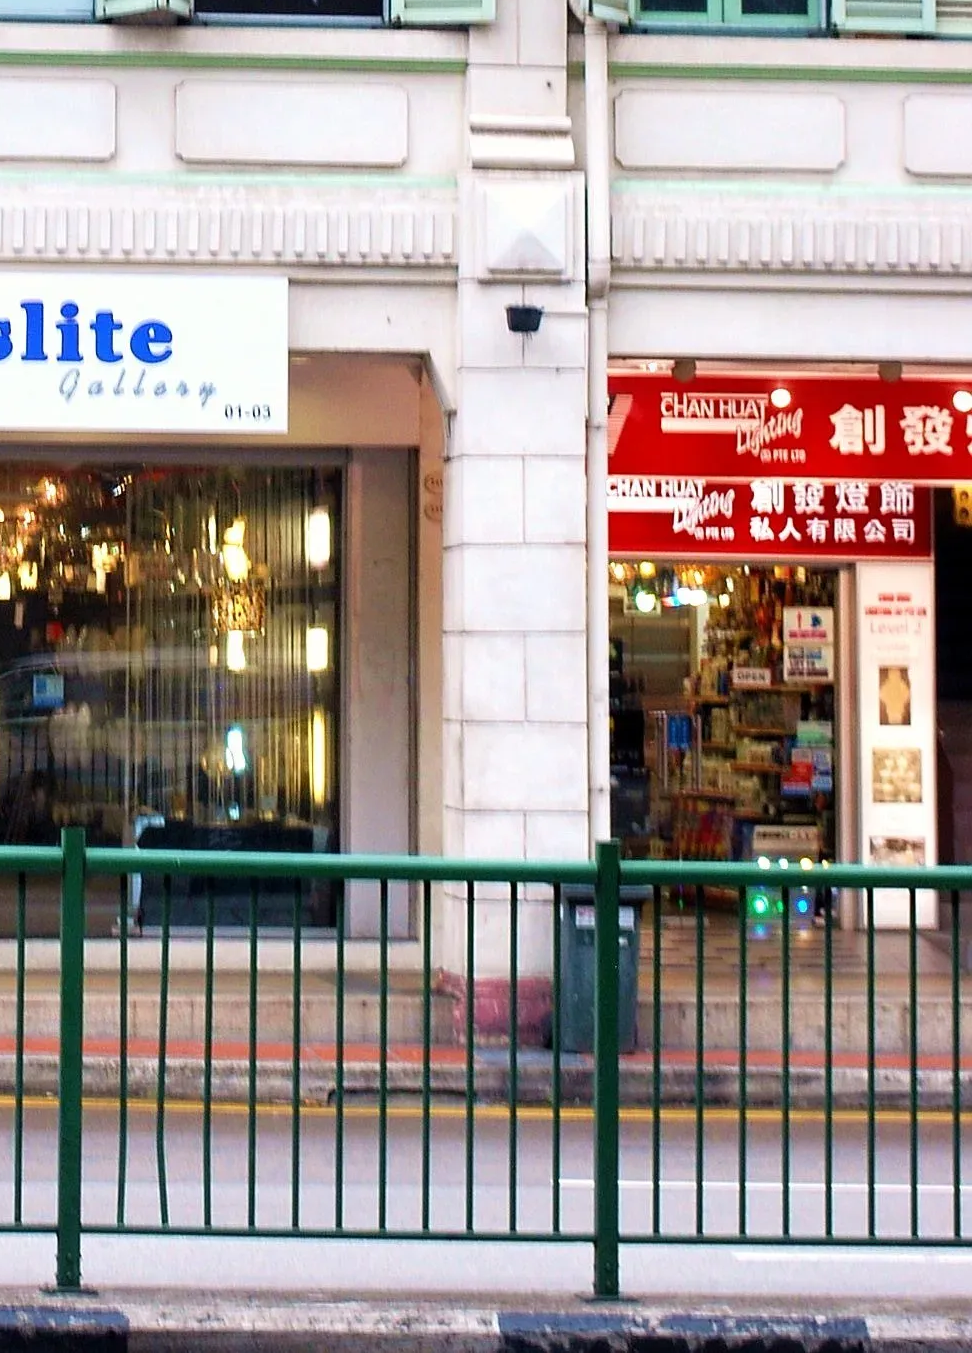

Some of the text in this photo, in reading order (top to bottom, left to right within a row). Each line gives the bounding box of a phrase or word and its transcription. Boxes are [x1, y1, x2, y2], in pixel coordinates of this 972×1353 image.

[58, 368, 217, 407] Gallery
[224, 404, 272, 422] 01-03
[660, 392, 769, 423] CHAN HUAT
[828, 403, 972, 456] 創發
[773, 449, 788, 463] PTE
[791, 449, 806, 463] LTD
[605, 477, 707, 499] CHAN HUAT
[749, 515, 916, 545] 私人有限公司
